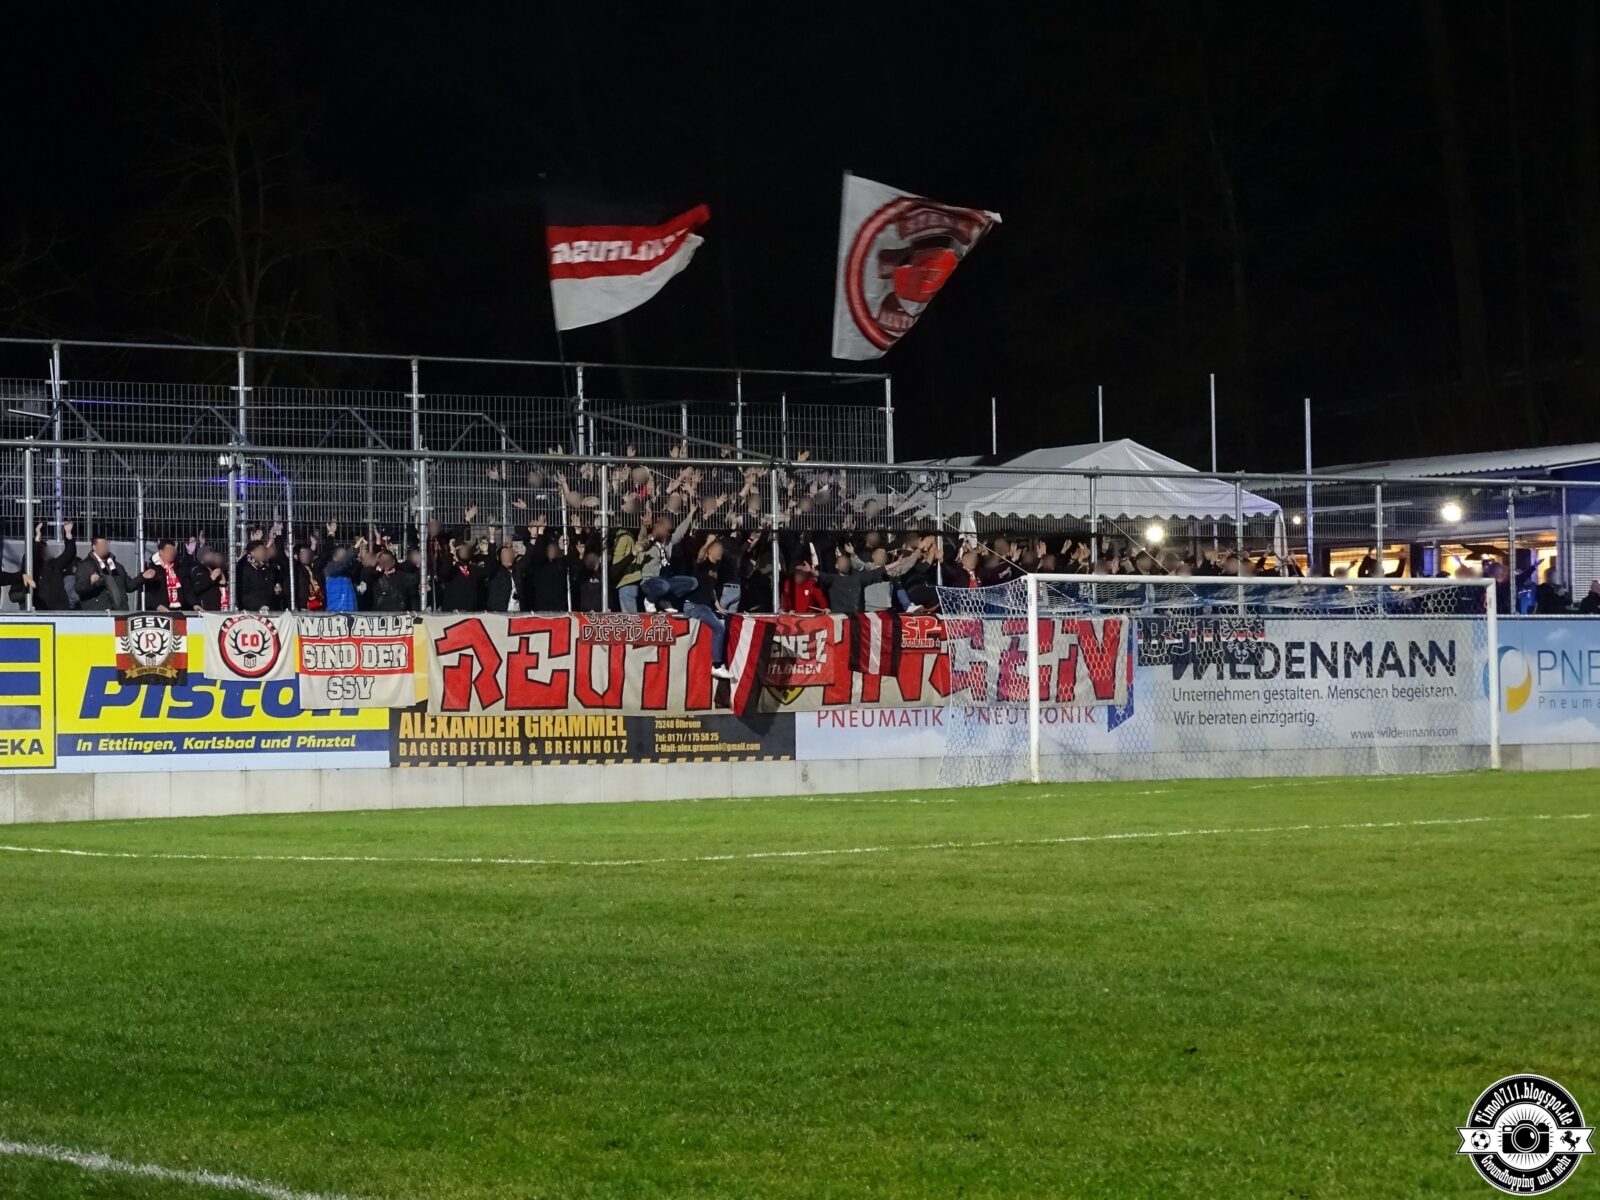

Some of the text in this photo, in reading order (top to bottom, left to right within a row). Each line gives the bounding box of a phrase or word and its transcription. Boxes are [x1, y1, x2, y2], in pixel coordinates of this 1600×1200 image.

[133, 617, 168, 630] SSV
[298, 615, 348, 638] WIR
[351, 615, 414, 637] ALLE
[582, 624, 674, 642] DIFFIDATI
[303, 643, 407, 669] SIND DER
[1537, 649, 1600, 686] PNE
[79, 666, 359, 720] Pisto
[327, 676, 374, 700] SSV
[1173, 683, 1457, 704] Unternehmen gestalten. Menschen begeistern.
[399, 712, 627, 739] ALEXANDER GRAMMEL
[817, 708, 943, 728] PNEUMATIK
[1174, 709, 1318, 728] Wir beraten einzigartig.
[76, 734, 357, 754] In Ettlingen, Karlsbad und Pfinztal
[399, 739, 628, 757] BAGGERBETRIEB & BRENNHOLZ
